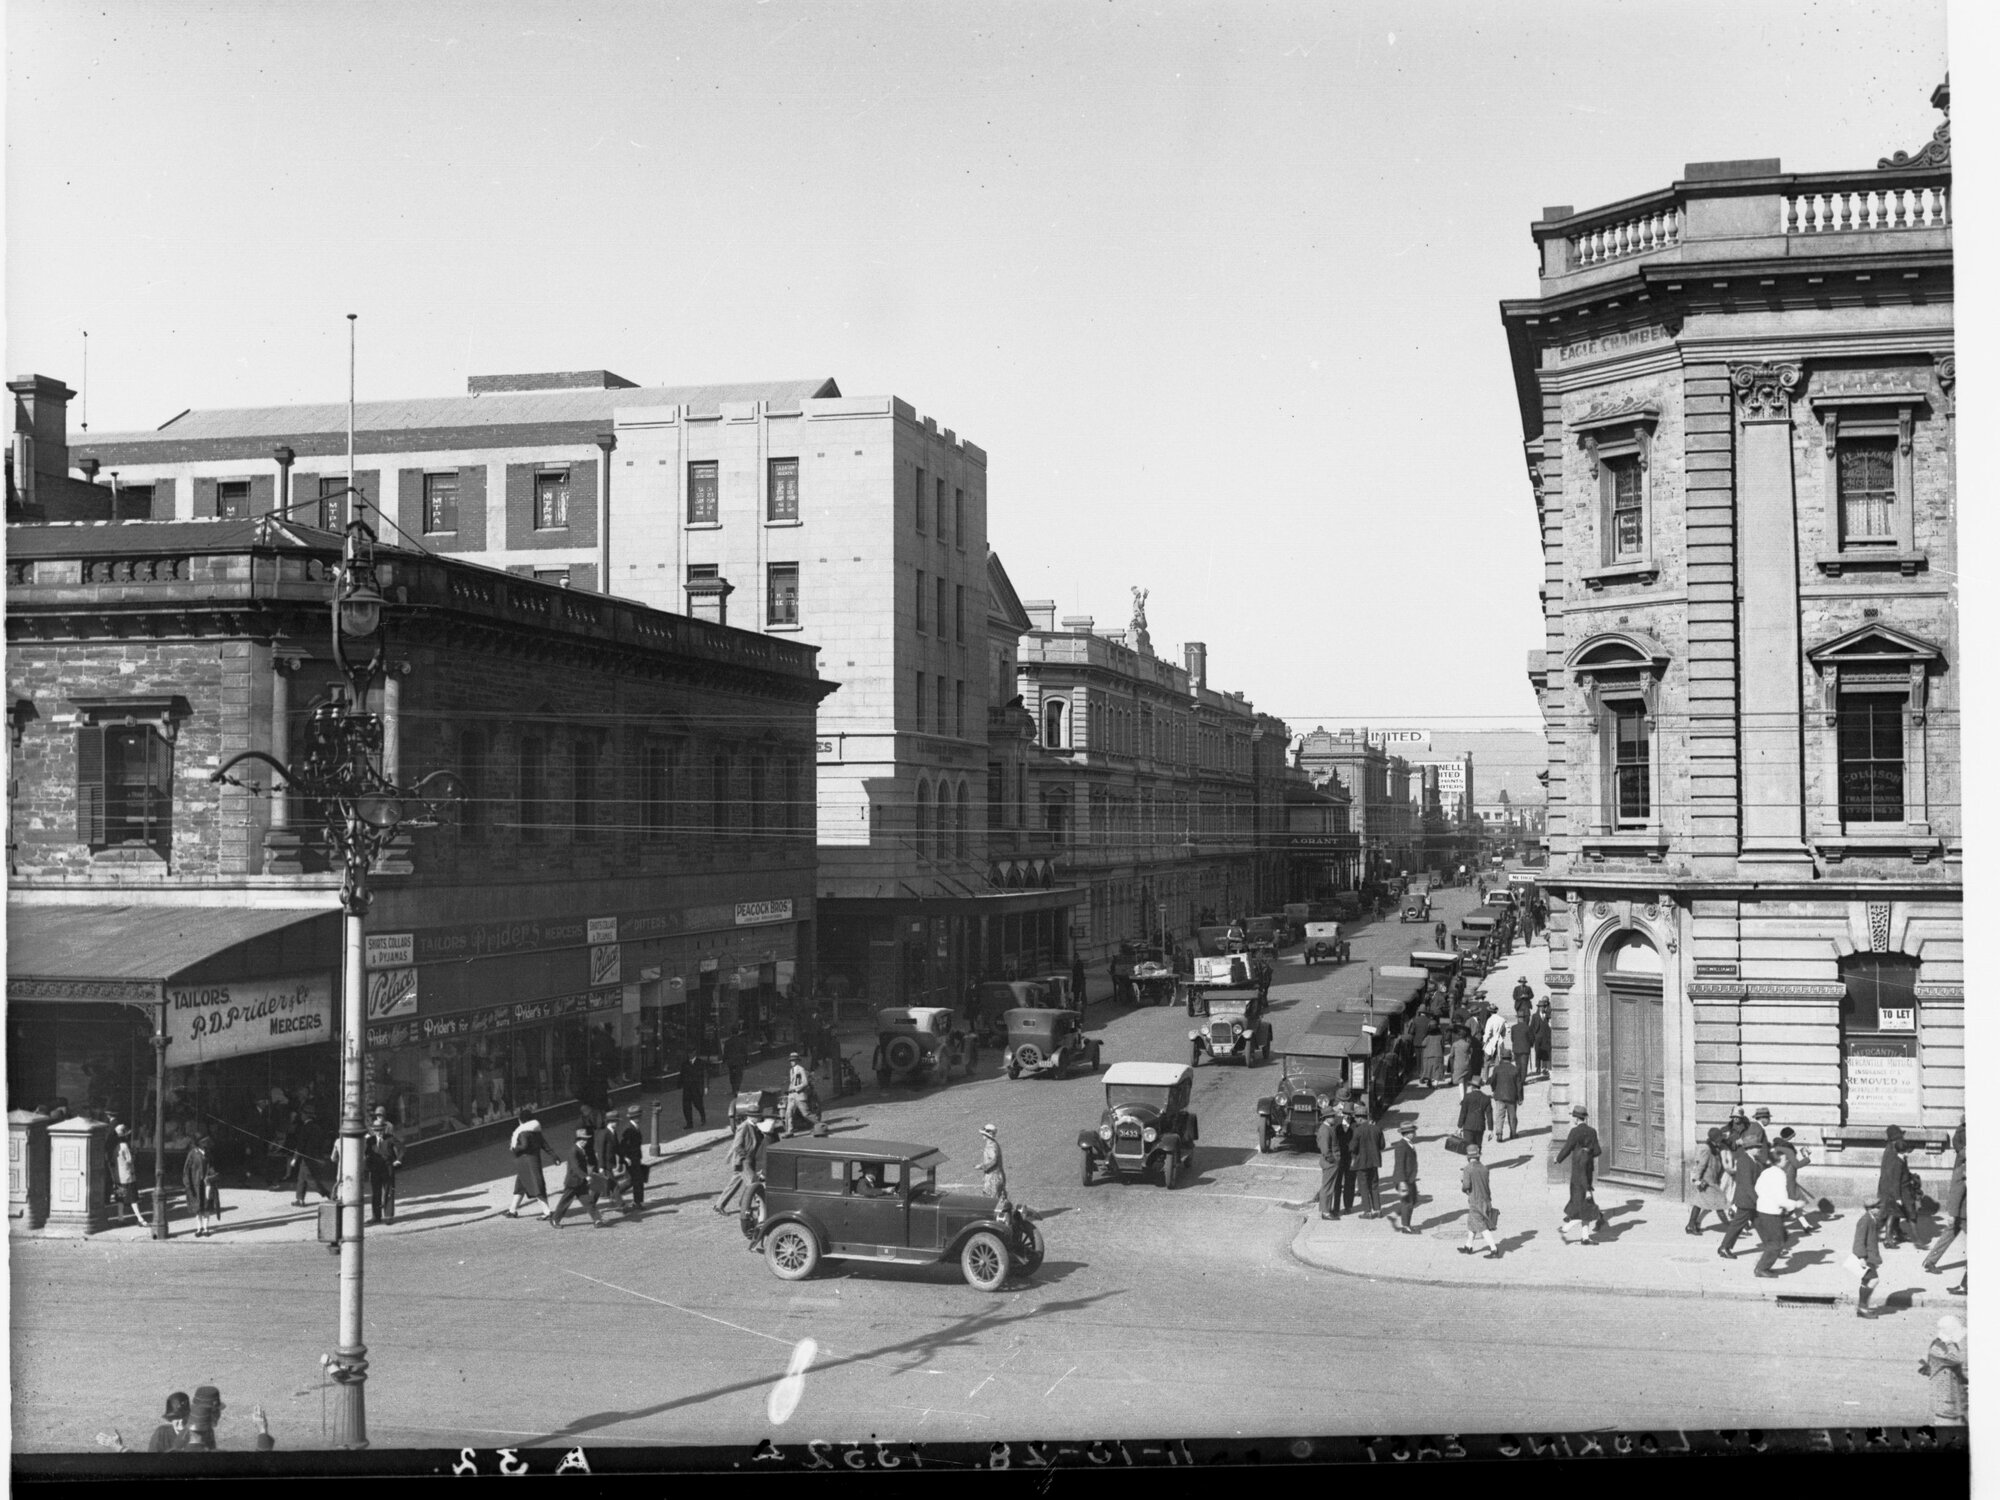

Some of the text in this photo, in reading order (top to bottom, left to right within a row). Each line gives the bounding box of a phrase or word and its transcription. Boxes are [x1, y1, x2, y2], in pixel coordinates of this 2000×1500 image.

[328, 502, 338, 529] MTPA
[432, 497, 442, 524] MTPA
[1370, 731, 1426, 742] IMITED.
[736, 903, 770, 917] PEACOCK
[420, 935, 467, 952] TAILORS
[379, 951, 408, 963] PYJAMAS
[1883, 1010, 1911, 1019] TO LET
[1845, 1077, 1898, 1086] REMOVED
